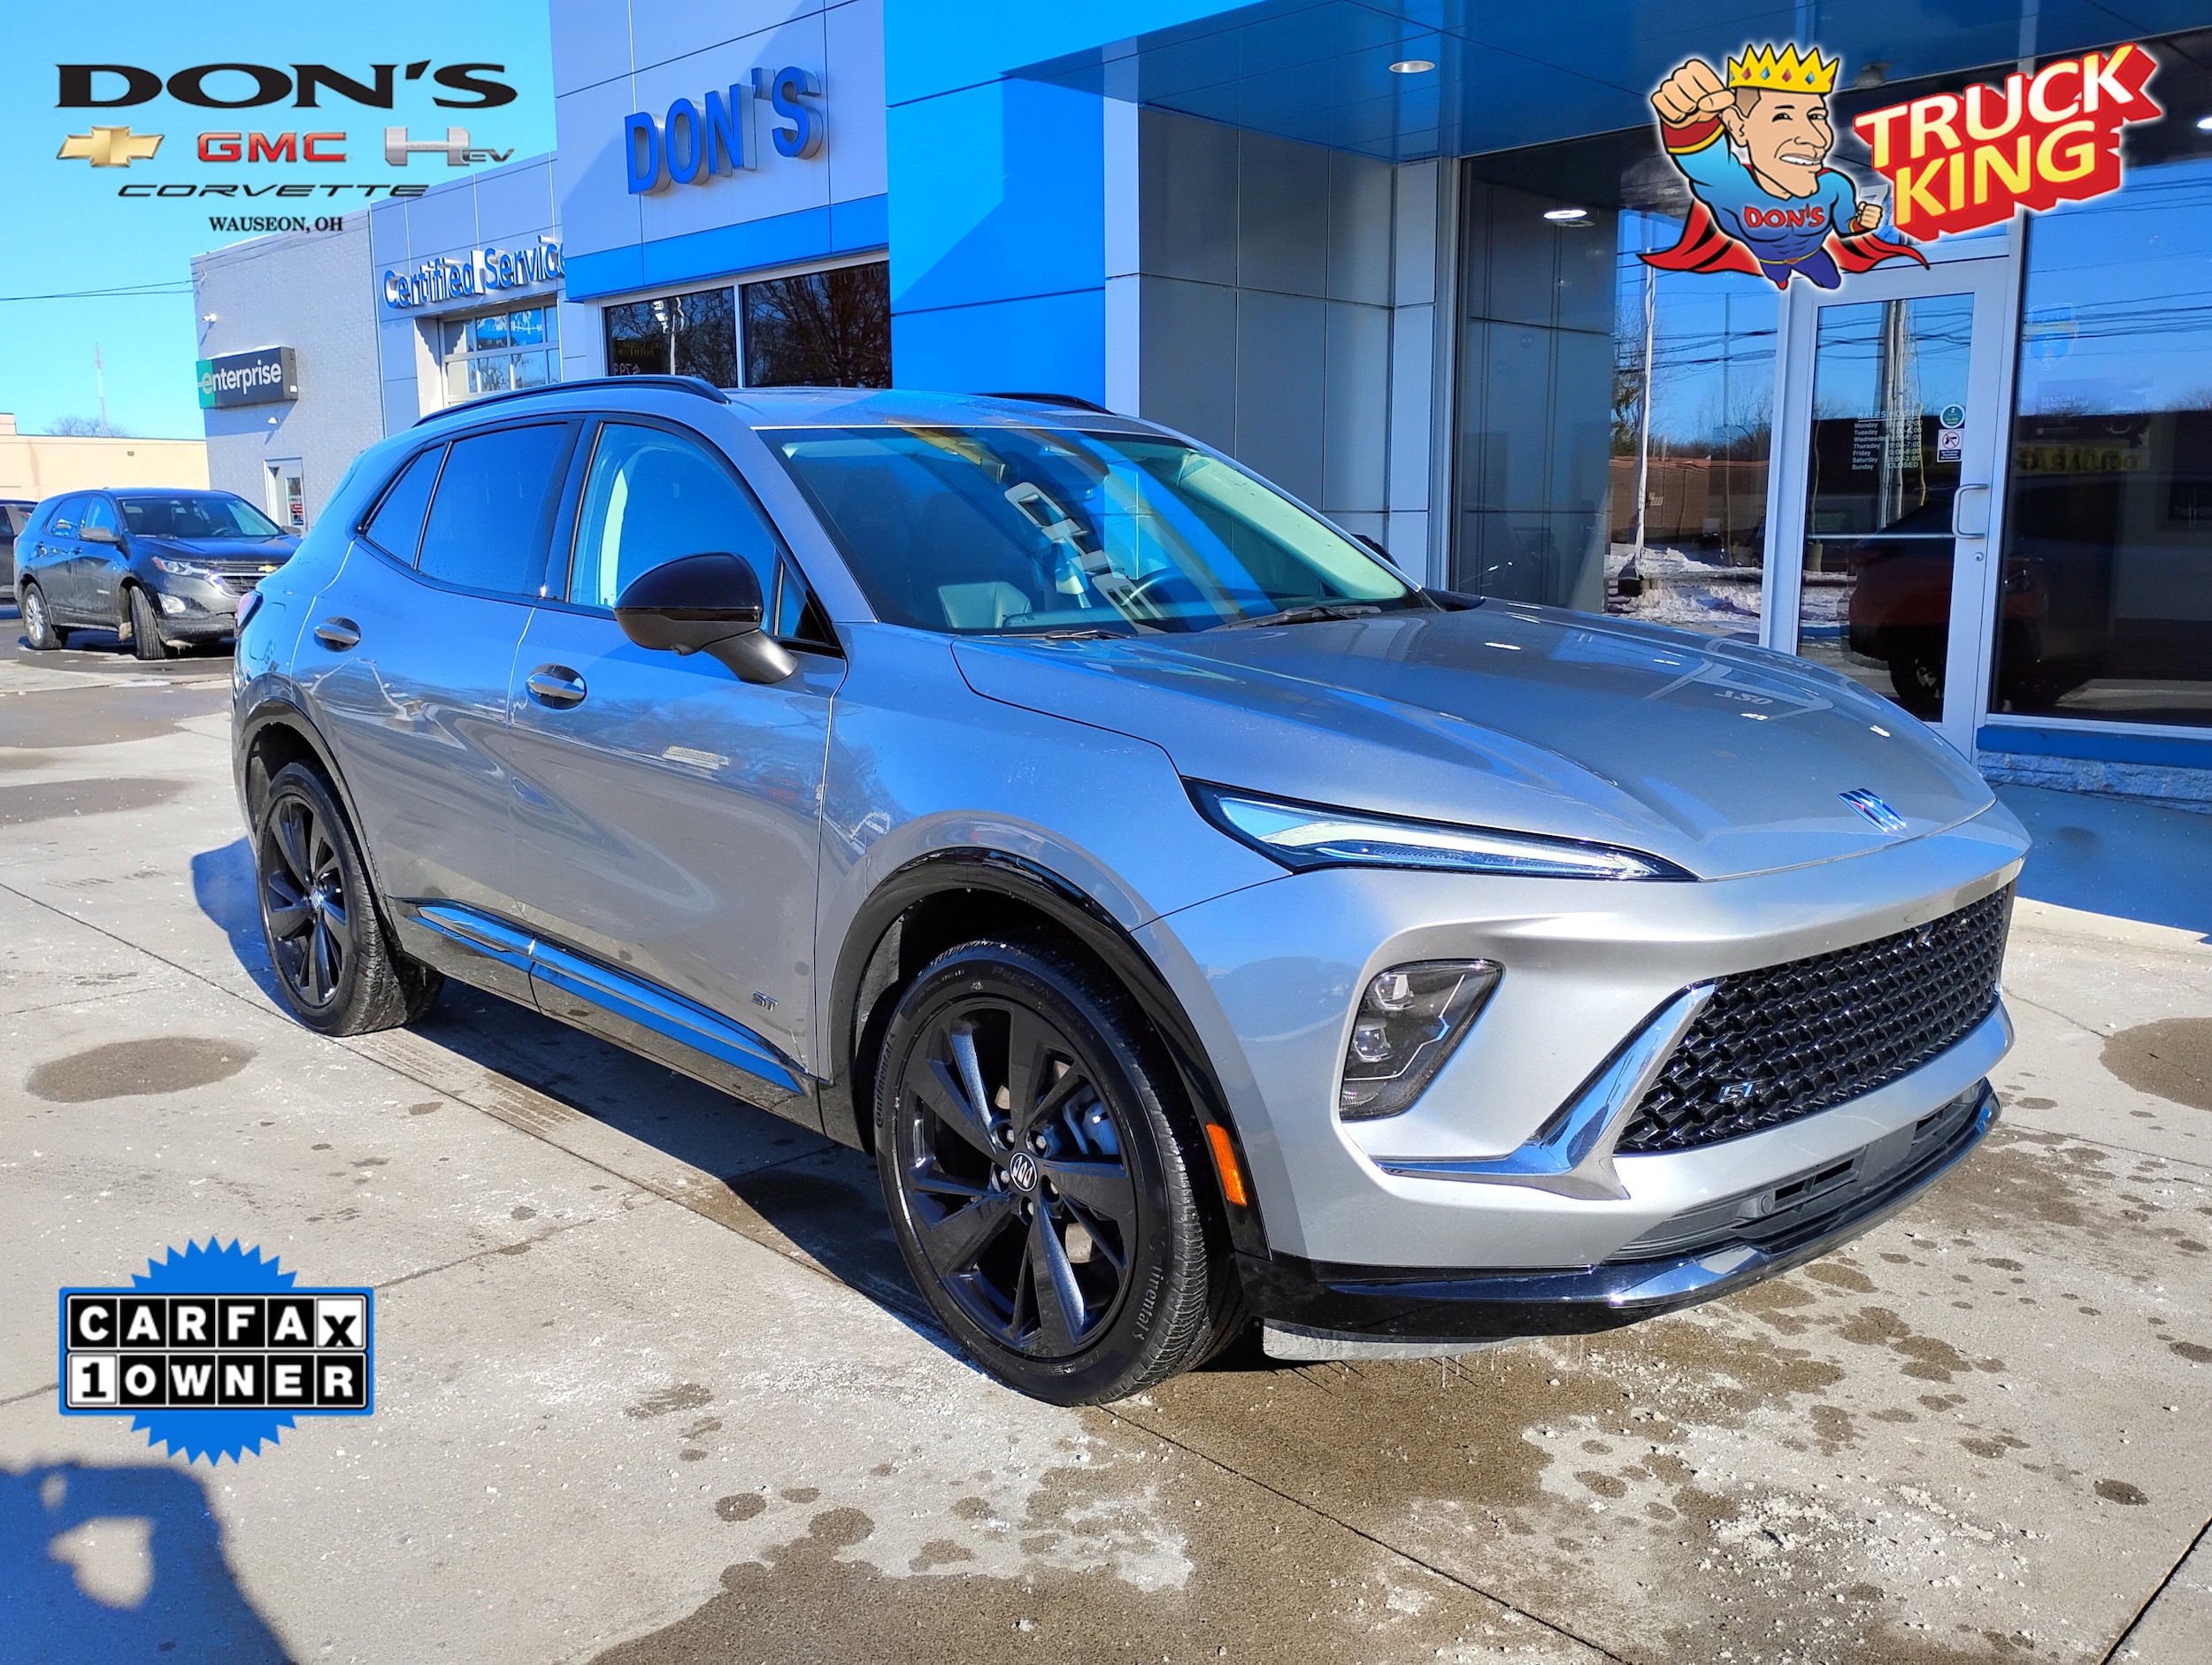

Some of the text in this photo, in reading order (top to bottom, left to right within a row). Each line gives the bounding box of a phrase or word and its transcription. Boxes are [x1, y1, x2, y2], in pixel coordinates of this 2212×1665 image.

[624, 66, 821, 195] DON'S
[382, 250, 484, 309] Certified
[198, 359, 281, 395] enterprise
